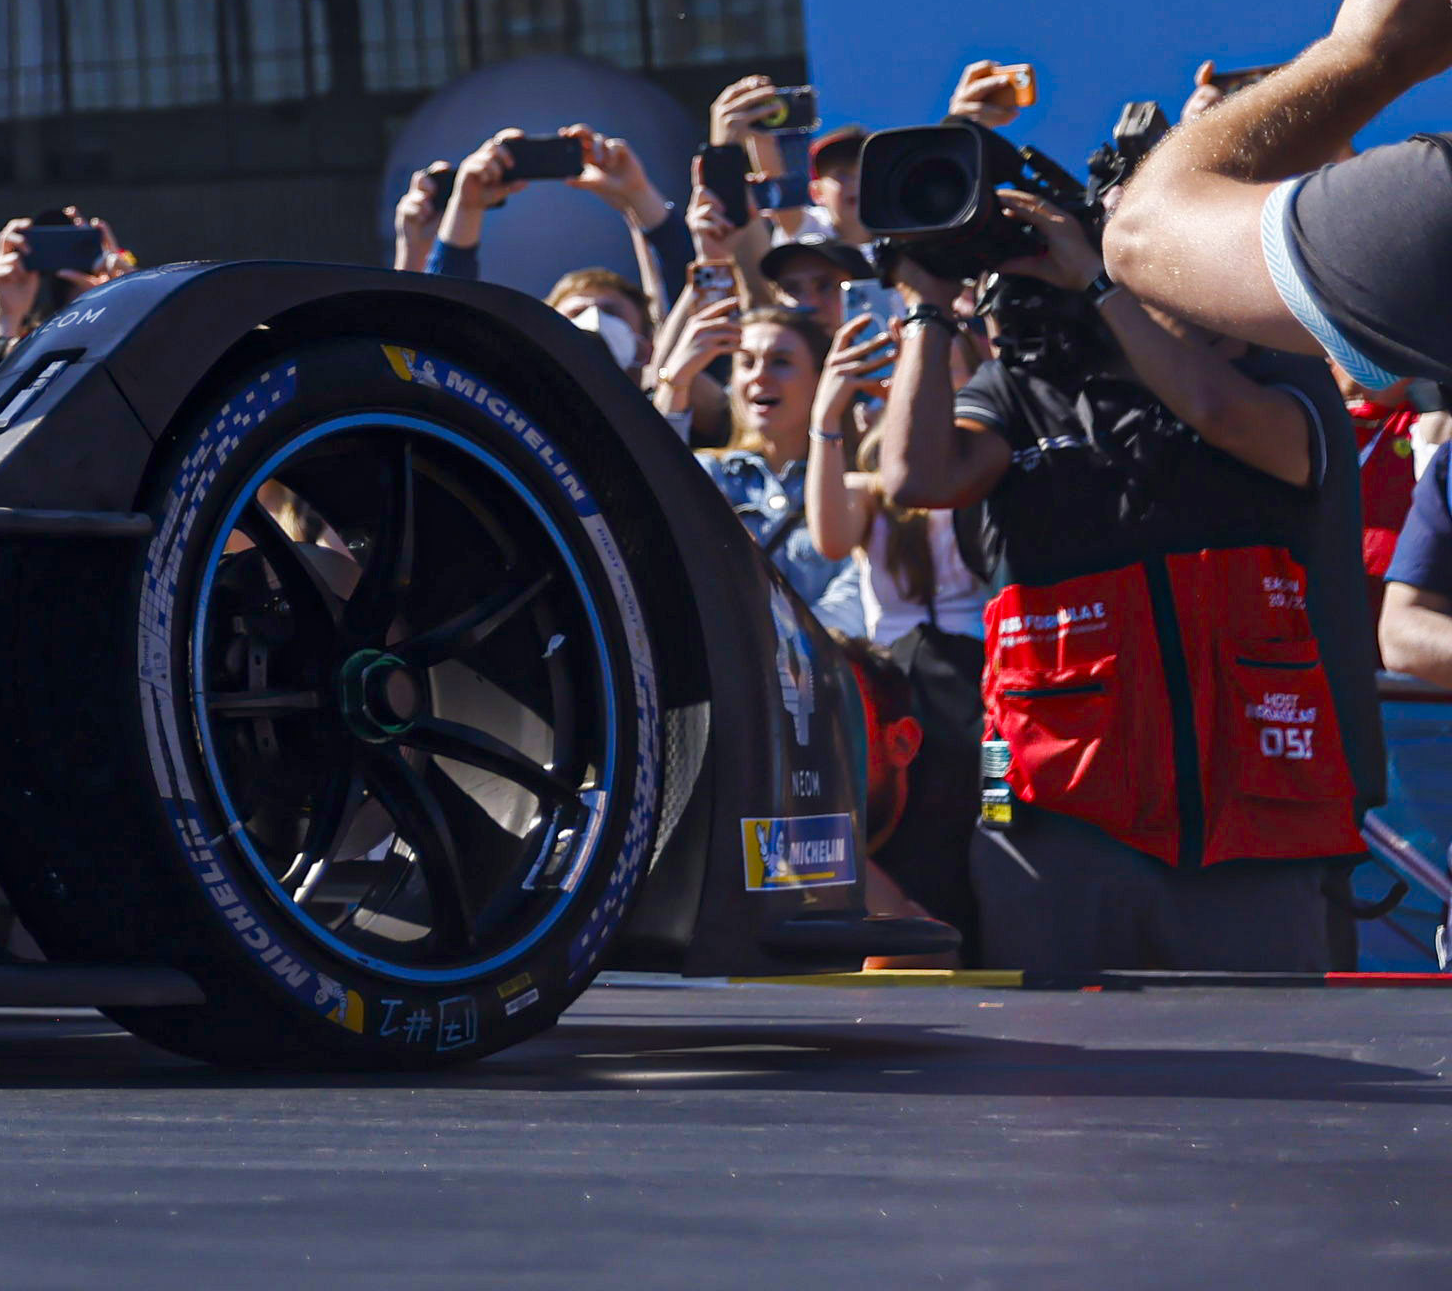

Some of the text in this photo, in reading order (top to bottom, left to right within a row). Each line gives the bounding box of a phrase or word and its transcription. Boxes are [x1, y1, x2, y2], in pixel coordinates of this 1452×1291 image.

[445, 369, 587, 503] MICHELIN
[791, 769, 821, 797] NEOM
[788, 837, 845, 866] MICHELIN
[176, 818, 311, 989] MICHELIN
